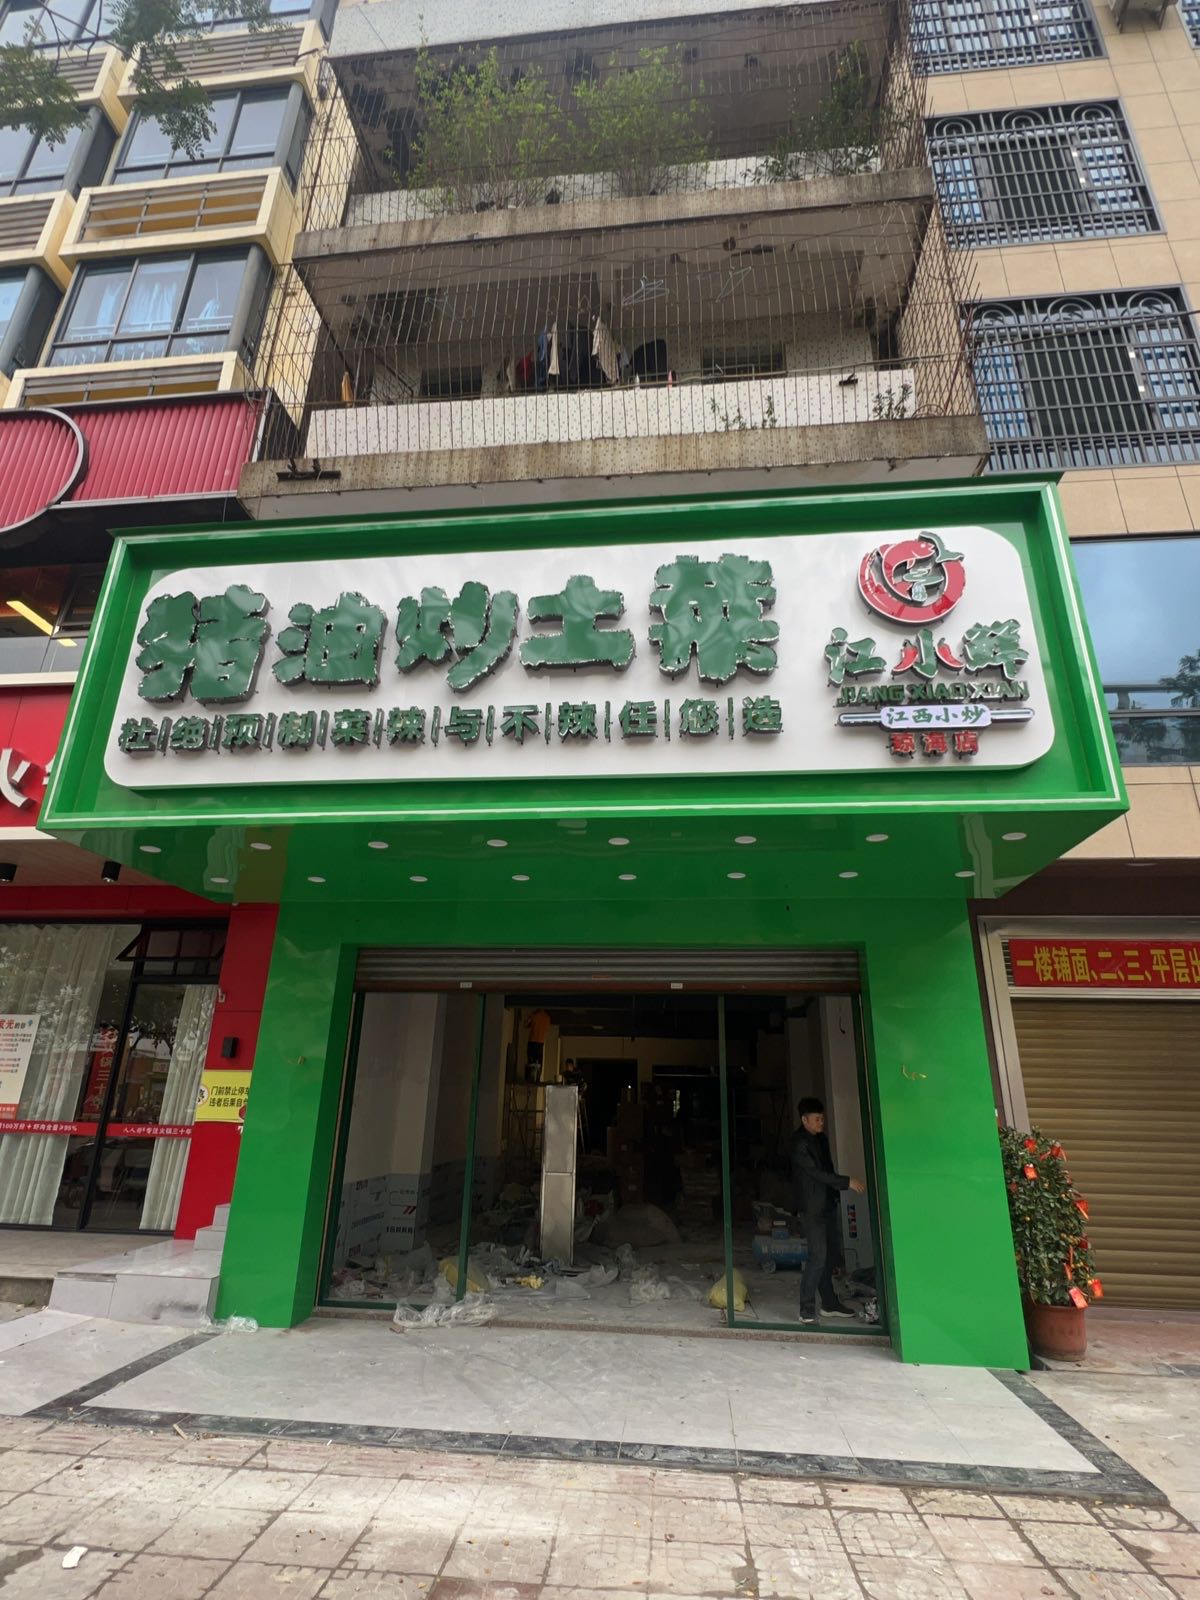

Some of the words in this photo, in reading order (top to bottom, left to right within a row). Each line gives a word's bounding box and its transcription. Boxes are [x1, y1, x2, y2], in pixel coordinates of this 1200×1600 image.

[837, 684, 905, 706] JIANG
[906, 682, 967, 703] XIAO
[968, 680, 1030, 702] XIAN
[886, 705, 987, 725] 江西小炒
